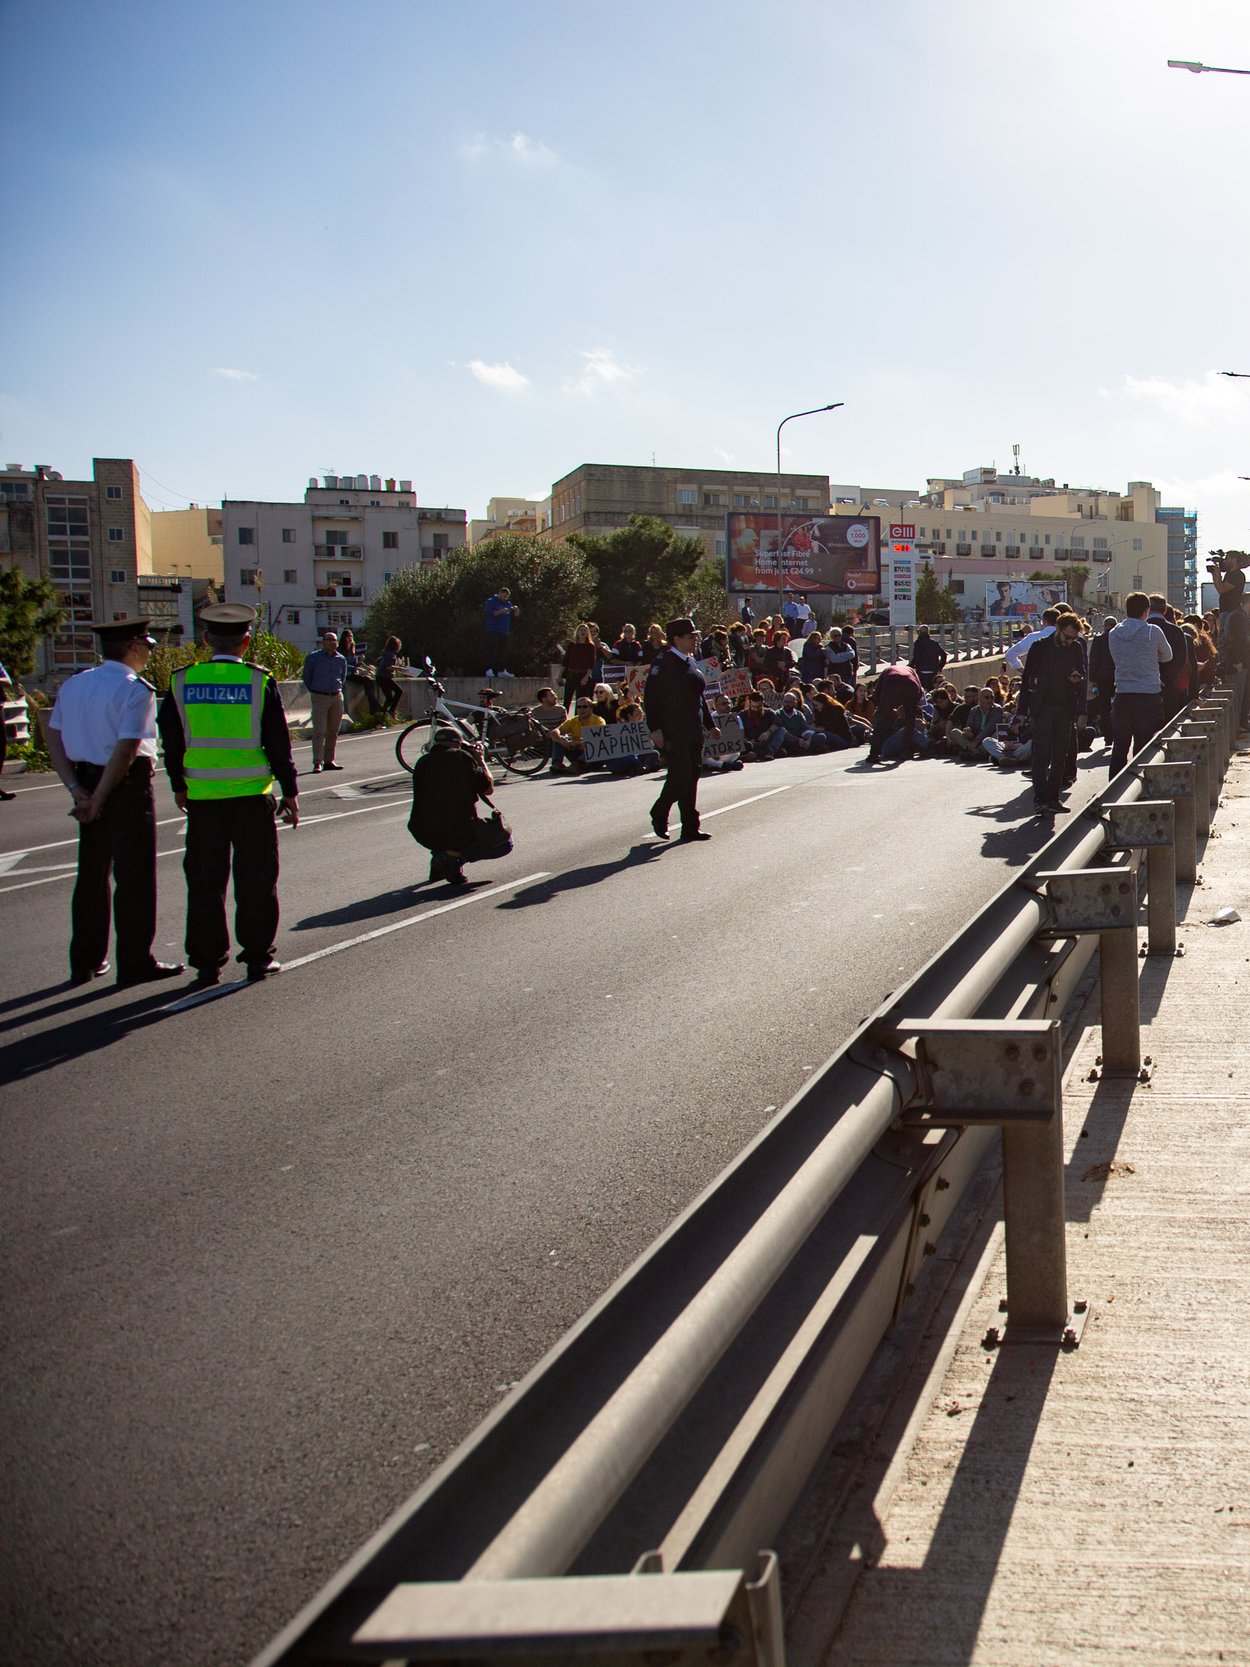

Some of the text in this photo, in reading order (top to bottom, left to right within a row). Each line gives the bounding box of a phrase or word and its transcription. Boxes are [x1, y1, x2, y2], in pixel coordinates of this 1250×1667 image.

[755, 549, 810, 558] Superfst Fibre
[755, 558, 777, 566] Home
[755, 567, 774, 575] from
[790, 567, 814, 575] €24.99
[187, 688, 248, 700] PULIZIJA
[590, 723, 646, 738] WE ARE
[585, 733, 652, 760] DAPHNE
[704, 739, 742, 758] ATORS
